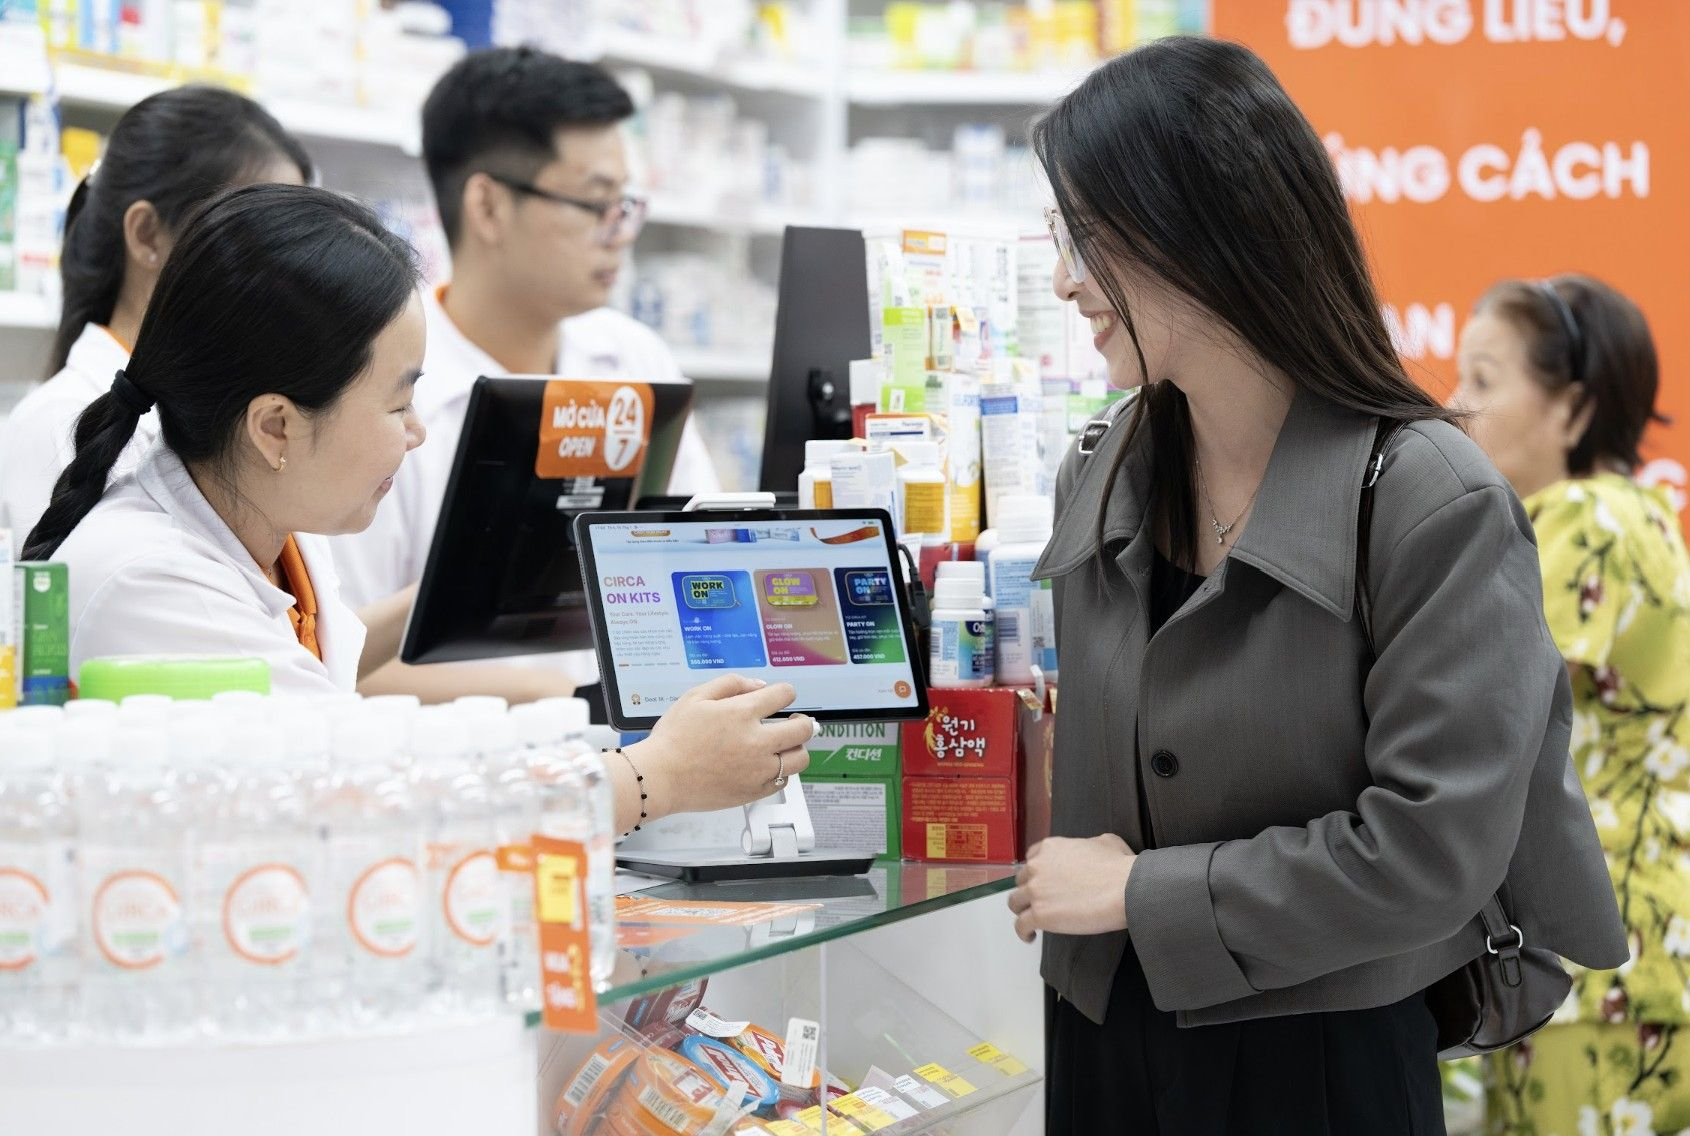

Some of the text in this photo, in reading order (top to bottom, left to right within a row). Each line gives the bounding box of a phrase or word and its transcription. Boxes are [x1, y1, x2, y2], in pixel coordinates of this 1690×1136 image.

[613, 397, 636, 426] 24
[558, 435, 597, 458] OPEN
[614, 438, 629, 466] 7
[603, 575, 646, 588] CIRCA
[691, 581, 724, 590] WORK
[771, 578, 801, 587] GLOW
[854, 577, 887, 587] PARTY
[693, 590, 709, 599] ON
[773, 586, 789, 595] ON
[855, 586, 871, 595] ON
[606, 591, 661, 604] ON KITS
[941, 714, 976, 736] 원기
[933, 733, 986, 759] 홍삼액
[845, 747, 883, 761] 컨디션
